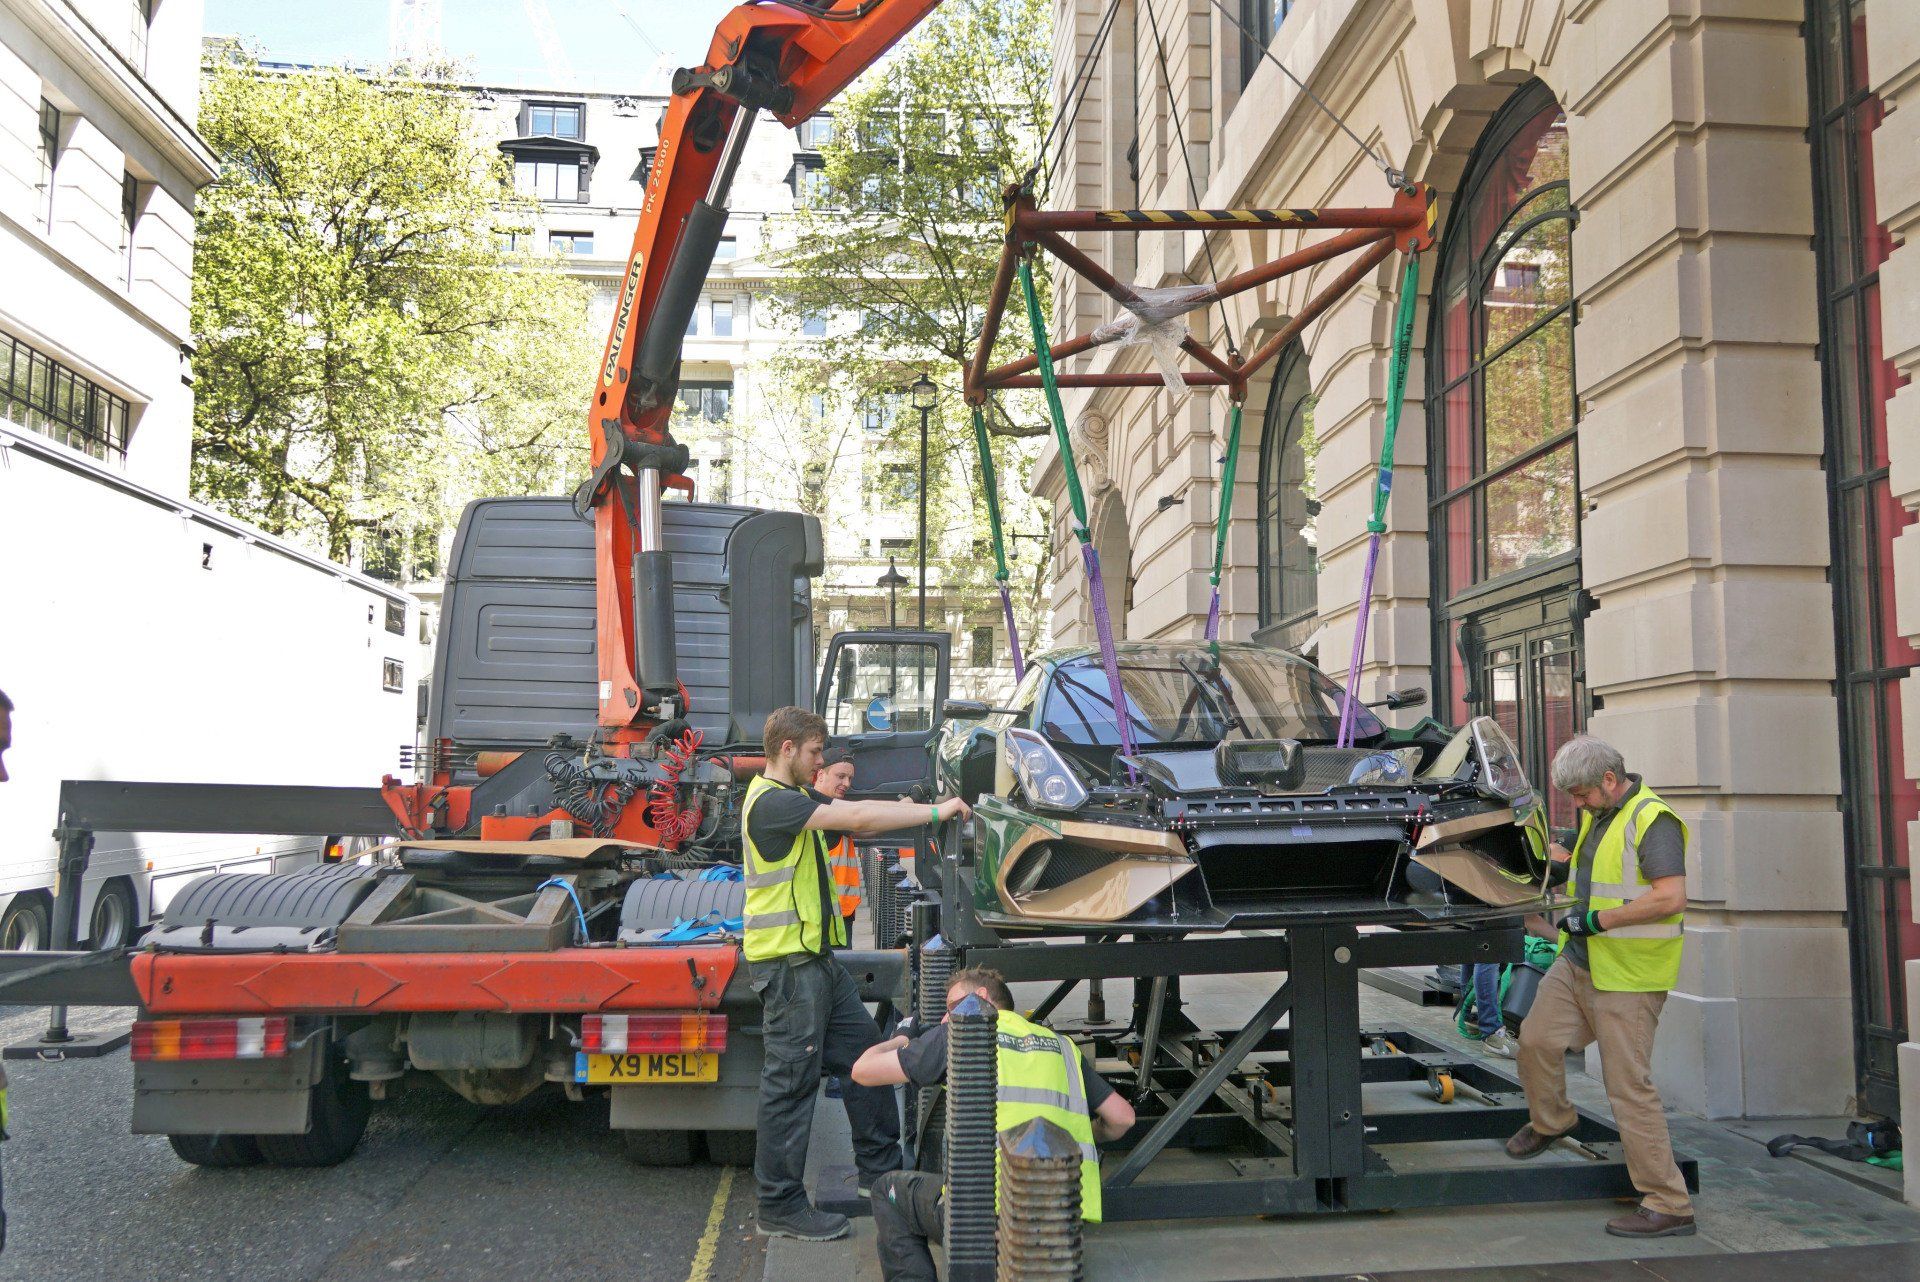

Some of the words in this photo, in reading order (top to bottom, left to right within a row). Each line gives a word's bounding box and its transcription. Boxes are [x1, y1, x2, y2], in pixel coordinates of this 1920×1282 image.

[645, 193, 657, 213] PK
[652, 139, 670, 187] 24500
[605, 260, 641, 379] PALFINGER
[997, 1033, 1017, 1045] SET
[609, 1054, 641, 1077] X9
[648, 1054, 696, 1077] MSL
